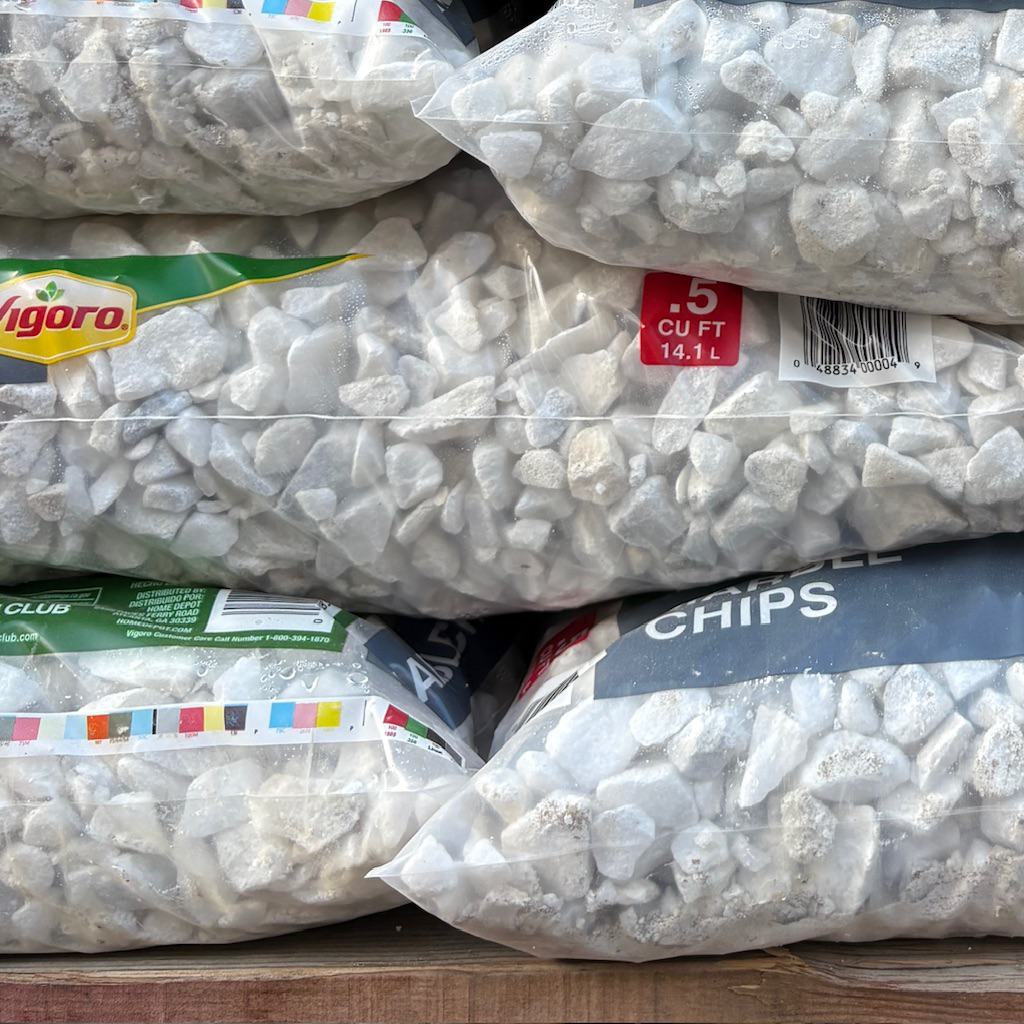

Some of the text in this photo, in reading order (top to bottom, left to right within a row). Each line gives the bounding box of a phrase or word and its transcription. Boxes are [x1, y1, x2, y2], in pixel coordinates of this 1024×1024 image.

[669, 279, 719, 315] .5
[657, 319, 726, 338] CU FT
[661, 343, 720, 360] 14.1 L
[793, 357, 921, 375] 0 48834 00004 9
[136, 588, 191, 600] DISTRIBUTED
[129, 594, 204, 608] DISTRIBUIDO POR:
[147, 601, 202, 613] HOME DEPOT
[3, 602, 71, 615] CLUB
[146, 610, 174, 618] FERRY
[175, 608, 200, 617] ROAD
[645, 581, 838, 641] CHIPS
[155, 617, 197, 625] GA 30339
[126, 630, 153, 639] Vigoro
[153, 633, 193, 642] Customer
[193, 635, 213, 643] Care
[231, 634, 264, 643] Number
[265, 634, 330, 643] 1-800-394-1870
